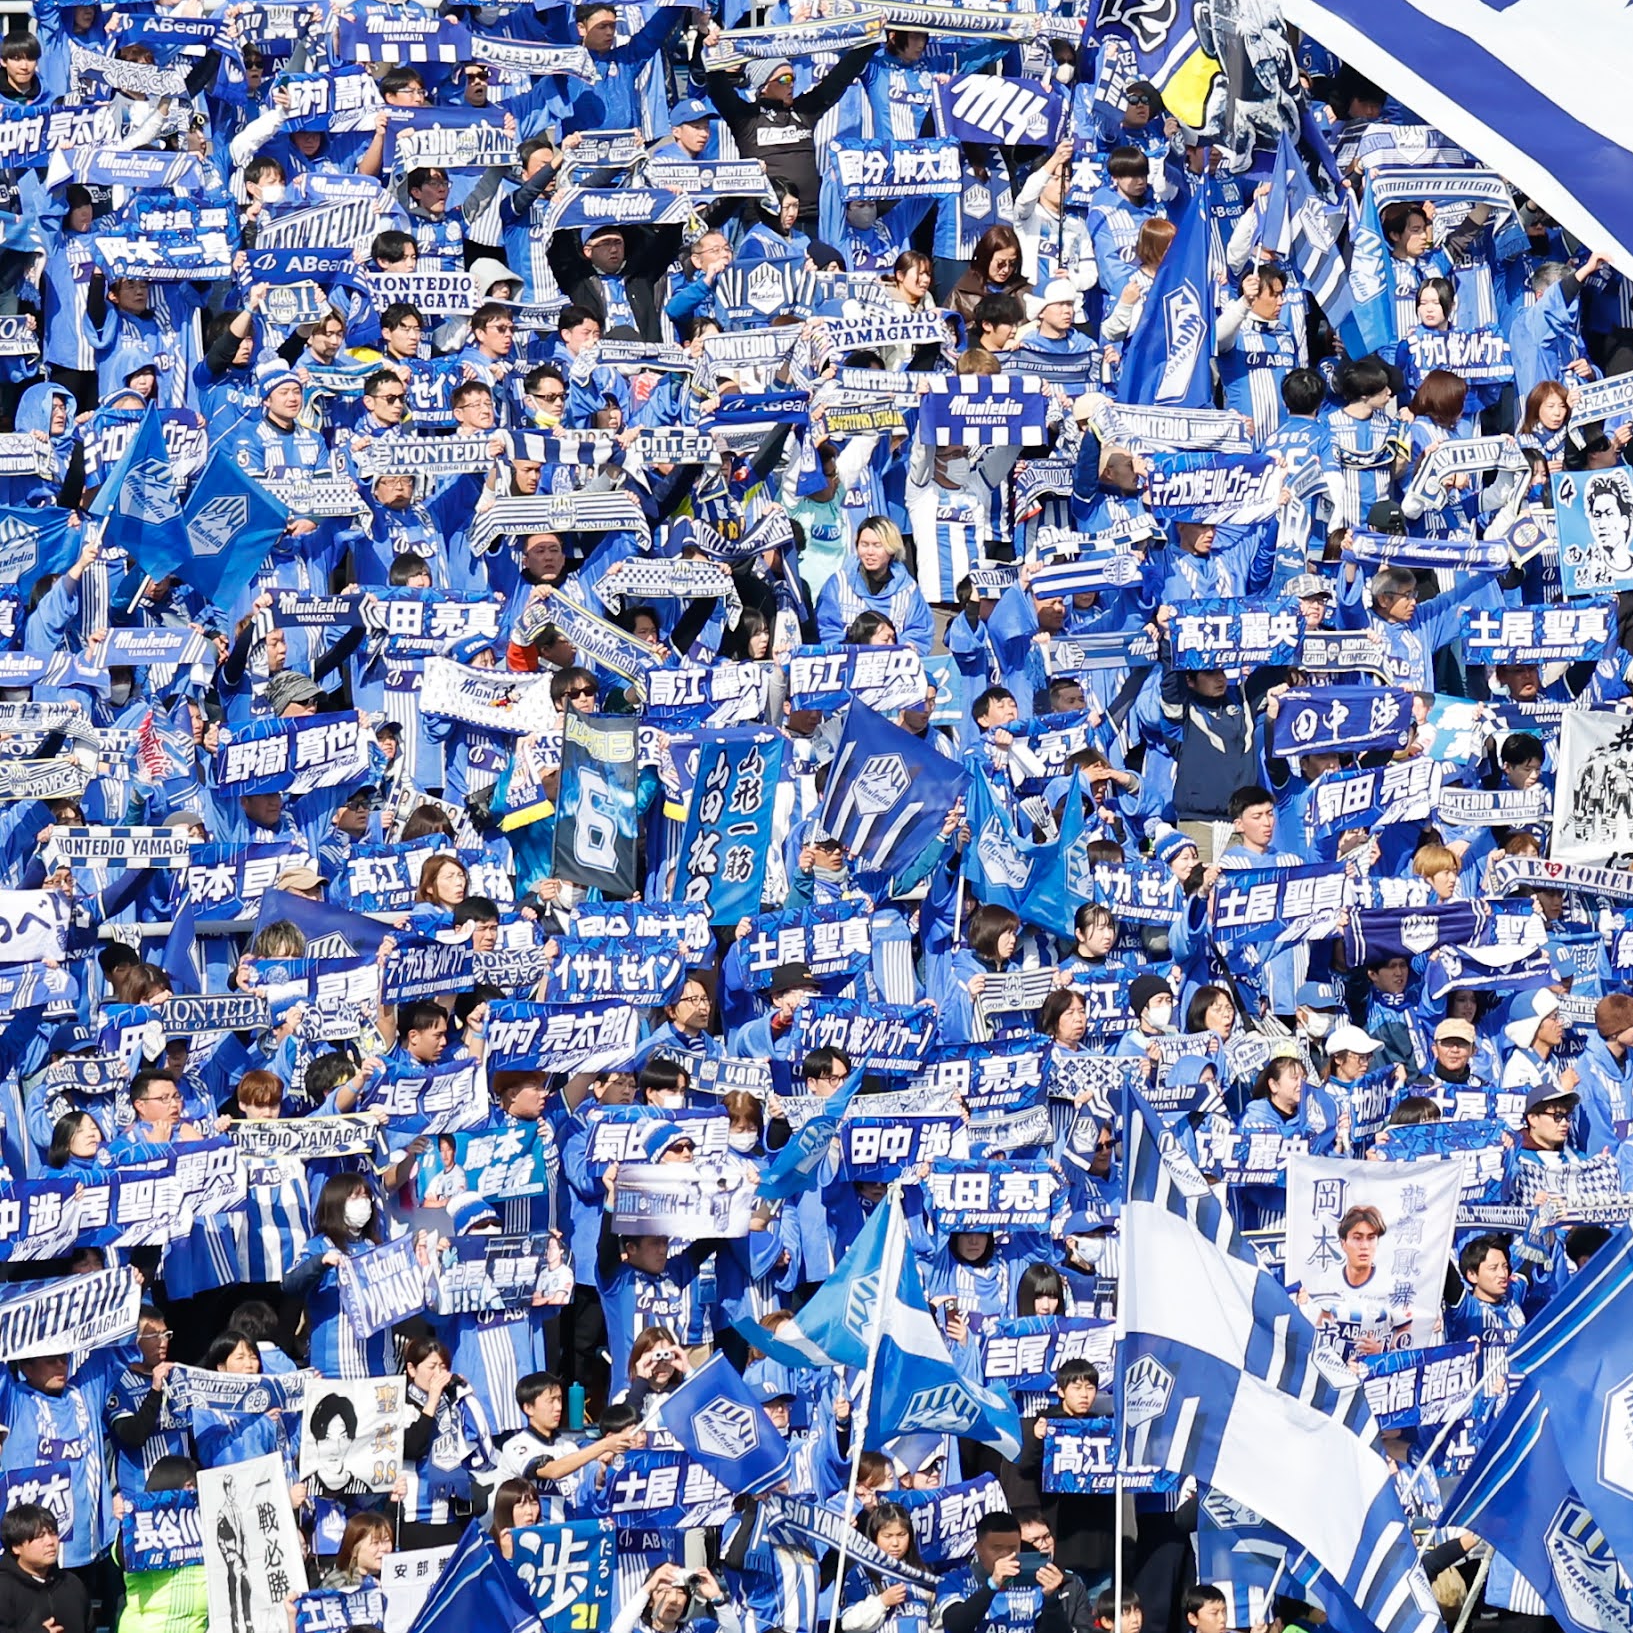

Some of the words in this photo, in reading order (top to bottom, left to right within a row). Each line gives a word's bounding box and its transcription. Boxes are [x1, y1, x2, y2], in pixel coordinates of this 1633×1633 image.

[144, 17, 215, 34] ABeam
[366, 16, 439, 31] Montedio
[934, 12, 1004, 30] YAMAGATA
[383, 32, 423, 41] YAMAGATA
[837, 148, 960, 183] 國分伸太郎
[286, 255, 354, 272] ABeam
[831, 324, 938, 348] YAMAGATA
[949, 395, 1021, 416] Montedio
[966, 416, 1005, 424] YAMAGATA
[279, 595, 348, 614] Montedio
[299, 613, 334, 622] YAMAGATA
[388, 600, 498, 634] 田亮真
[1470, 602, 1605, 647] 土居聖真
[114, 631, 183, 649] Montedio
[577, 768, 620, 870] 6
[1219, 877, 1342, 926] 土居聖真
[751, 925, 871, 970] 土居聖真
[554, 951, 681, 993] イサカゼイン
[852, 1124, 952, 1162] 田中渉
[373, 1461, 399, 1488] 88
[254, 1477, 292, 1604] 一戦必勝
[518, 1527, 590, 1621] 渉
[572, 1603, 598, 1630] 21
